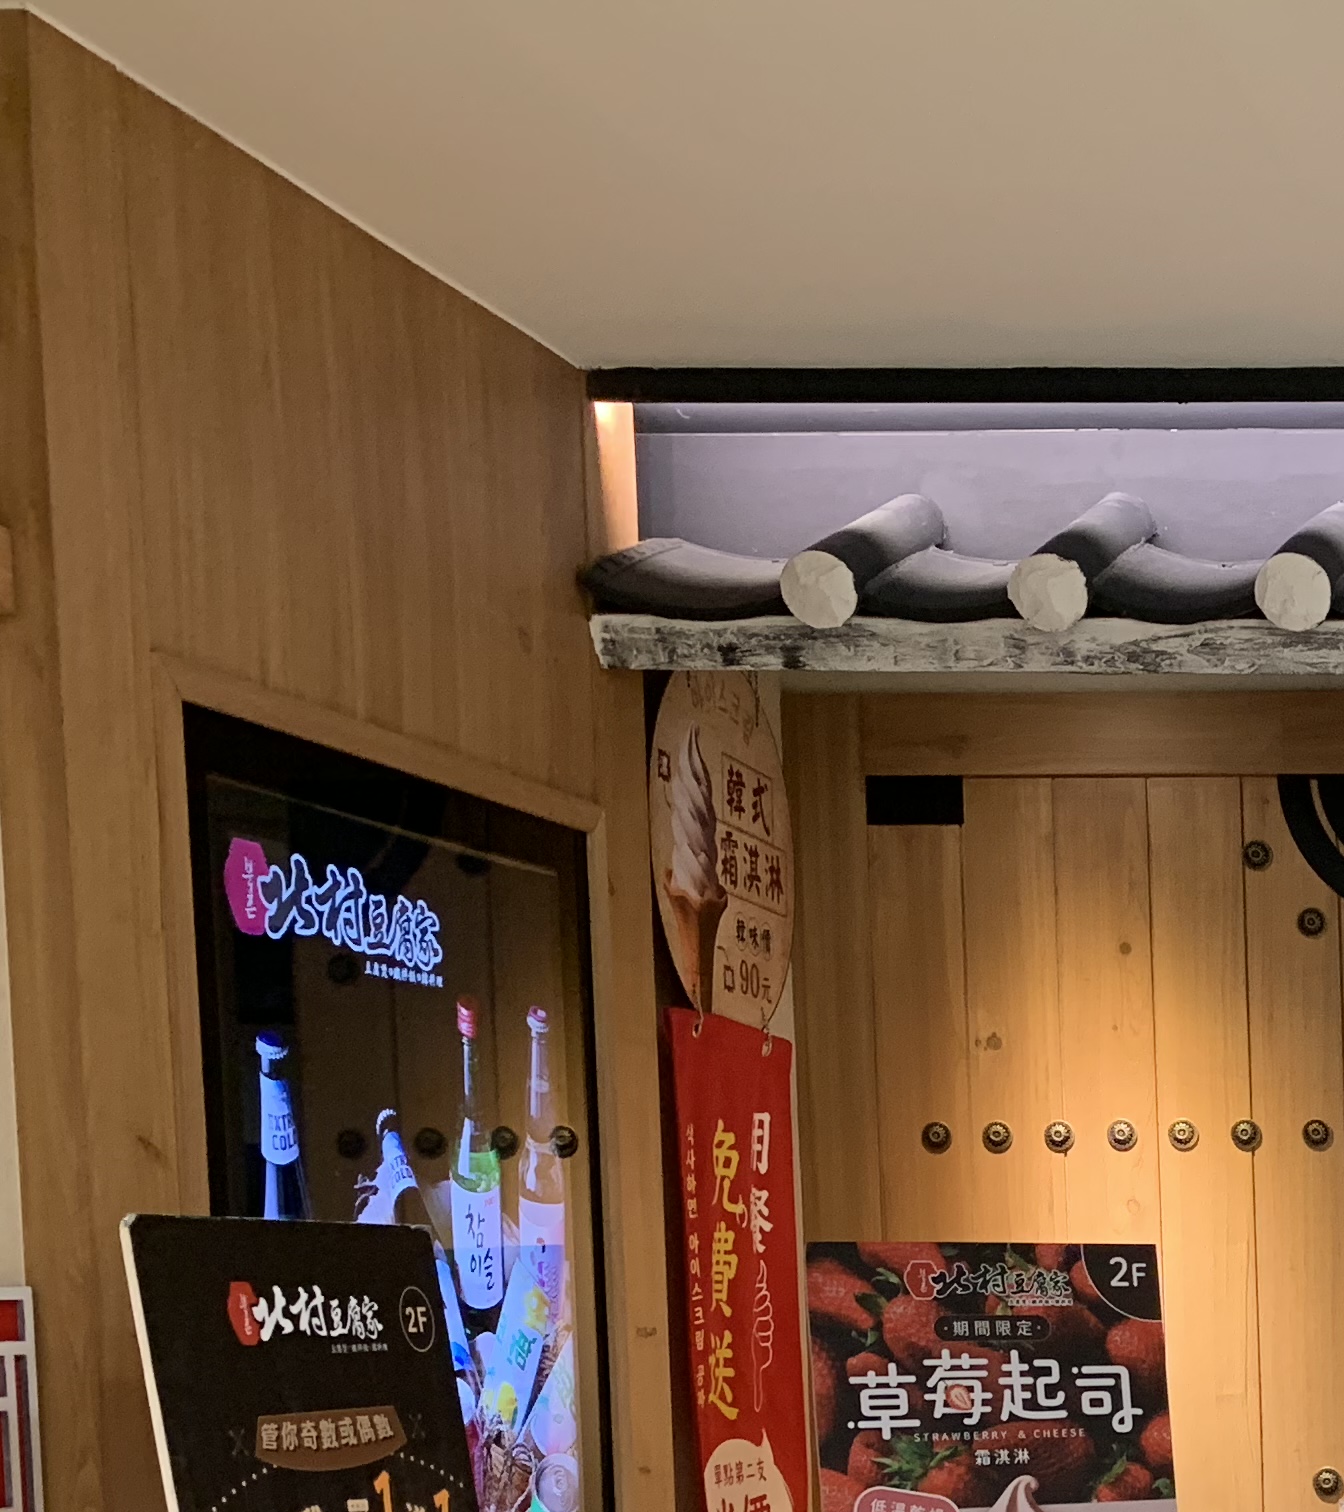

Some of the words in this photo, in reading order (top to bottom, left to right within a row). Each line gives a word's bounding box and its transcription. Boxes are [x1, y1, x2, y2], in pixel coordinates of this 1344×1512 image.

[726, 764, 771, 837] 韓式
[720, 831, 785, 905] 霜淇淋
[257, 853, 443, 971] 北村豆腐家
[740, 959, 773, 1004] 90元
[750, 1111, 774, 1254] 用餐
[708, 1118, 745, 1421] 免費送
[929, 1263, 1072, 1298] 北村豆腐家
[1109, 1256, 1147, 1287] 2F
[252, 1285, 383, 1342] 北村豆腐家
[405, 1306, 428, 1334] 2F
[952, 1320, 1033, 1337] 期間限定
[848, 1349, 1143, 1440] 草莓起司
[260, 1413, 395, 1451] 管你奇數或偶數
[914, 1430, 1008, 1443] STRAWBERRY
[1018, 1429, 1027, 1440] &
[1033, 1427, 1086, 1440] CHEESE
[974, 1448, 1030, 1466] 霜淇淋
